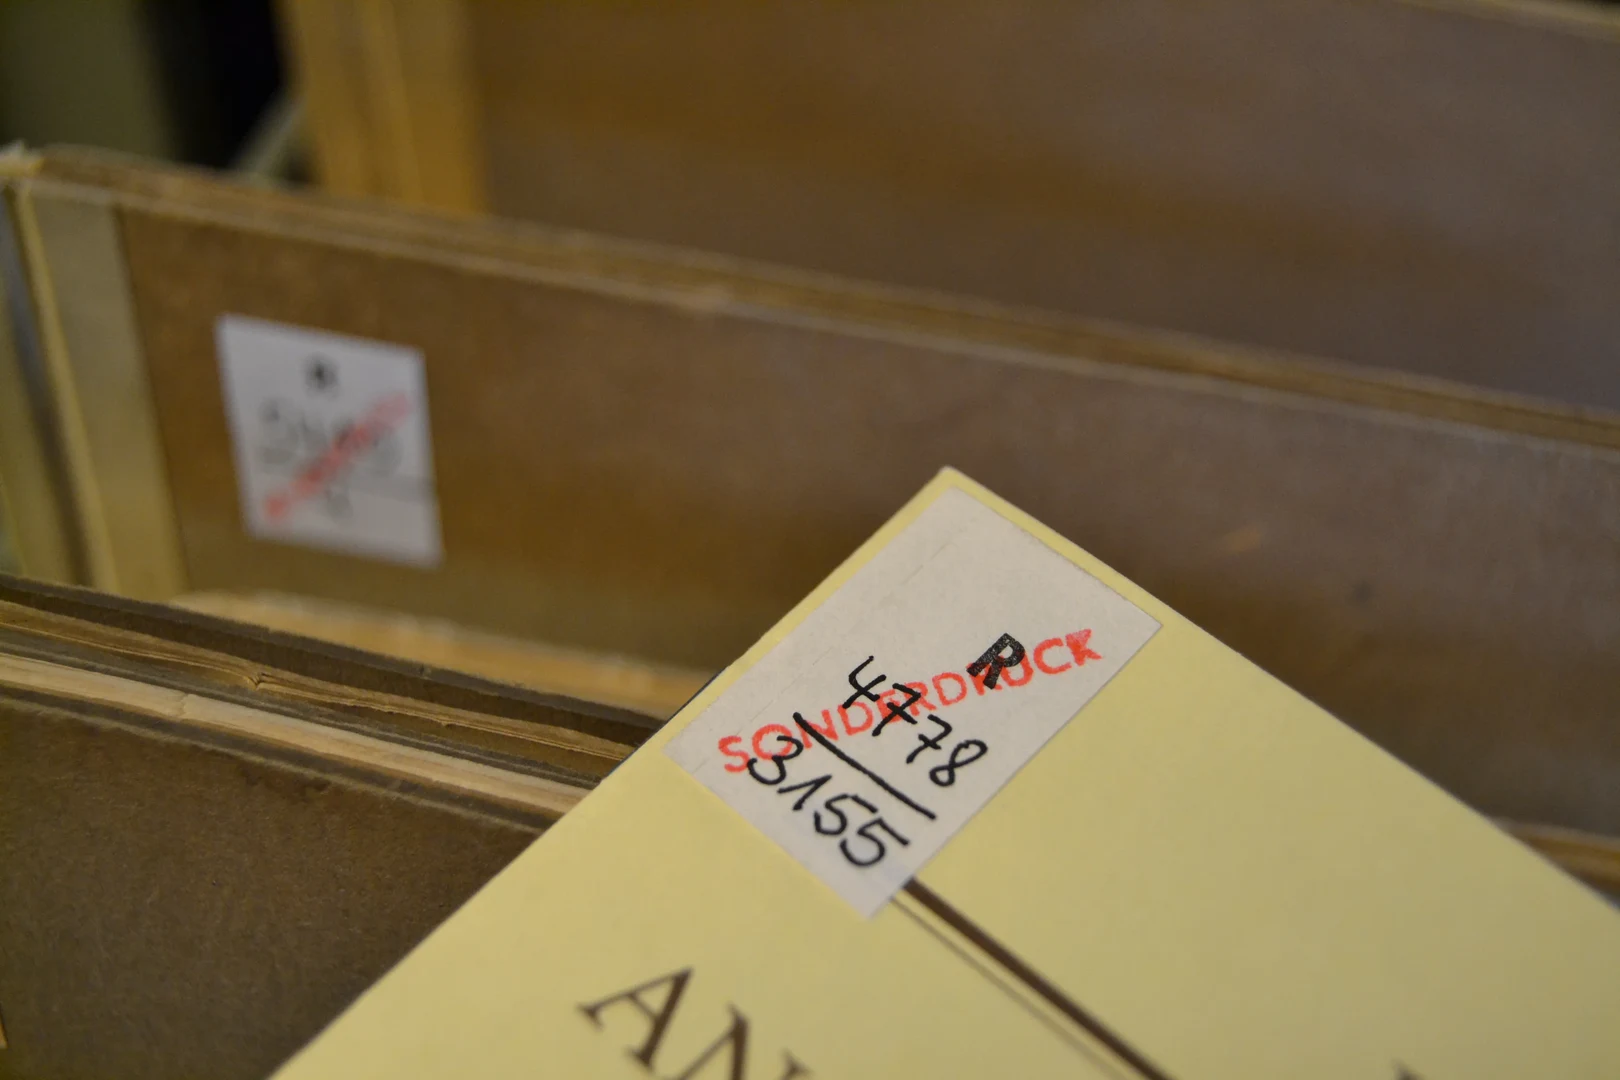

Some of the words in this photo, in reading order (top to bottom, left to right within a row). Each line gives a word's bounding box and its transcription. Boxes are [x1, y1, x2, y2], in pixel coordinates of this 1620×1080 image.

[843, 655, 988, 786] 4778
[967, 633, 1025, 689] R
[747, 734, 909, 867] 3155
